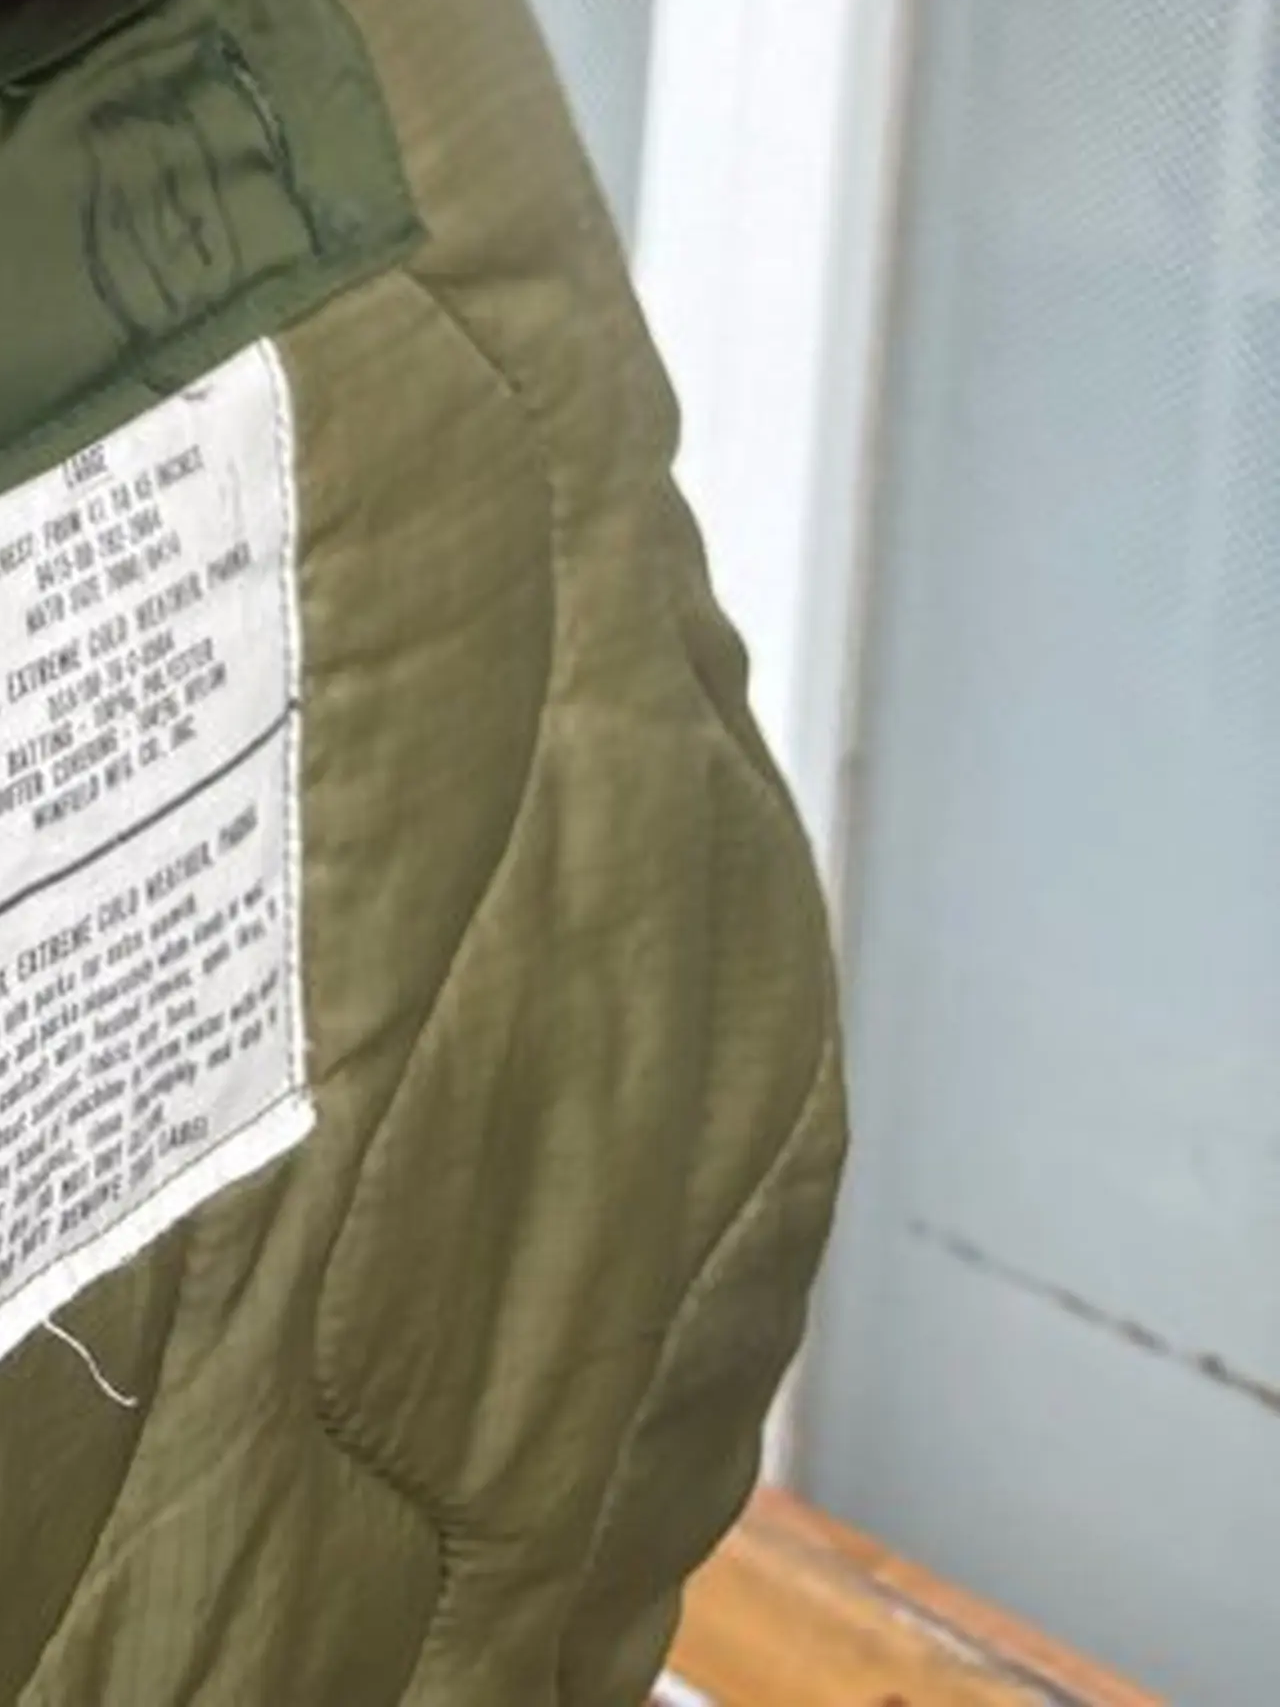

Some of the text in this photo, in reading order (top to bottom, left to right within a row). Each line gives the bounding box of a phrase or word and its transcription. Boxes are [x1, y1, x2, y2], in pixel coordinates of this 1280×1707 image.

[41, 508, 82, 550] FROM
[5, 637, 82, 705] EXTREME
[87, 613, 128, 660] COLD
[6, 719, 74, 778] BATTING
[141, 636, 214, 699] POLYESTER
[51, 725, 118, 789] COVERING
[183, 662, 227, 706] NYLON
[16, 912, 92, 984] EXTREME
[96, 885, 139, 934] COLD
